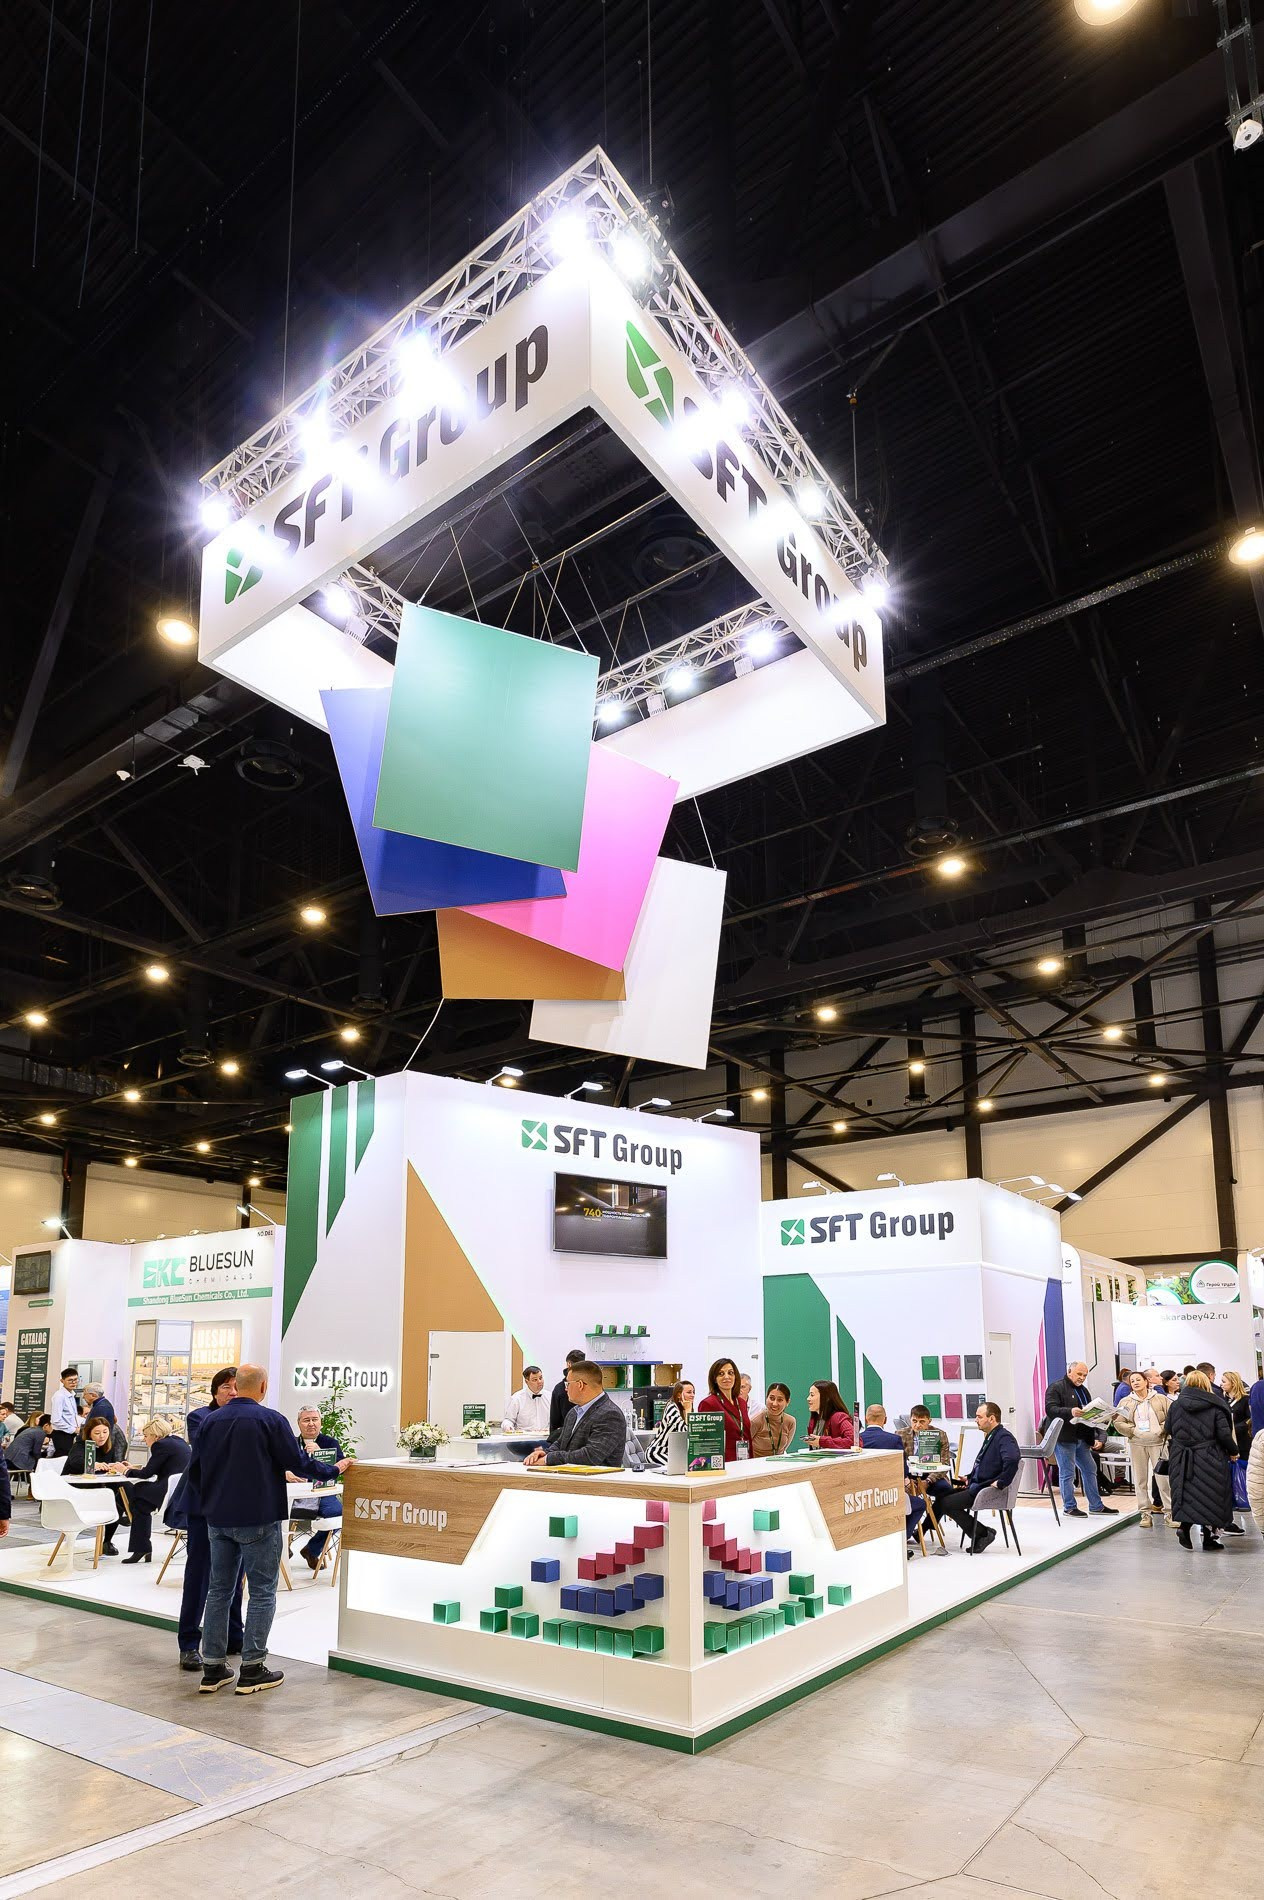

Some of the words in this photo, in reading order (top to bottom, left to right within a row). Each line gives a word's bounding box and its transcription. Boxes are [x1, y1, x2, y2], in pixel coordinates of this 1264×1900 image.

[553, 1124, 607, 1158] SFT
[612, 1133, 683, 1175] Group
[583, 1207, 602, 1217] 740
[810, 1213, 864, 1244] SFT
[869, 1211, 955, 1240] Group
[190, 1249, 254, 1272] BLUESUN
[143, 1295, 168, 1304] Shandong
[169, 1293, 193, 1303] BlueSun
[194, 1291, 223, 1301] Chemicals
[21, 1332, 47, 1346] CATALOG
[192, 1327, 235, 1348] LUESUN
[311, 1366, 340, 1387] SFT
[343, 1366, 388, 1392] Group
[87, 1452, 93, 1466] 5
[854, 1488, 873, 1512] SFT
[874, 1487, 899, 1507] Group
[370, 1499, 401, 1522] SFT
[402, 1502, 448, 1532] Group
